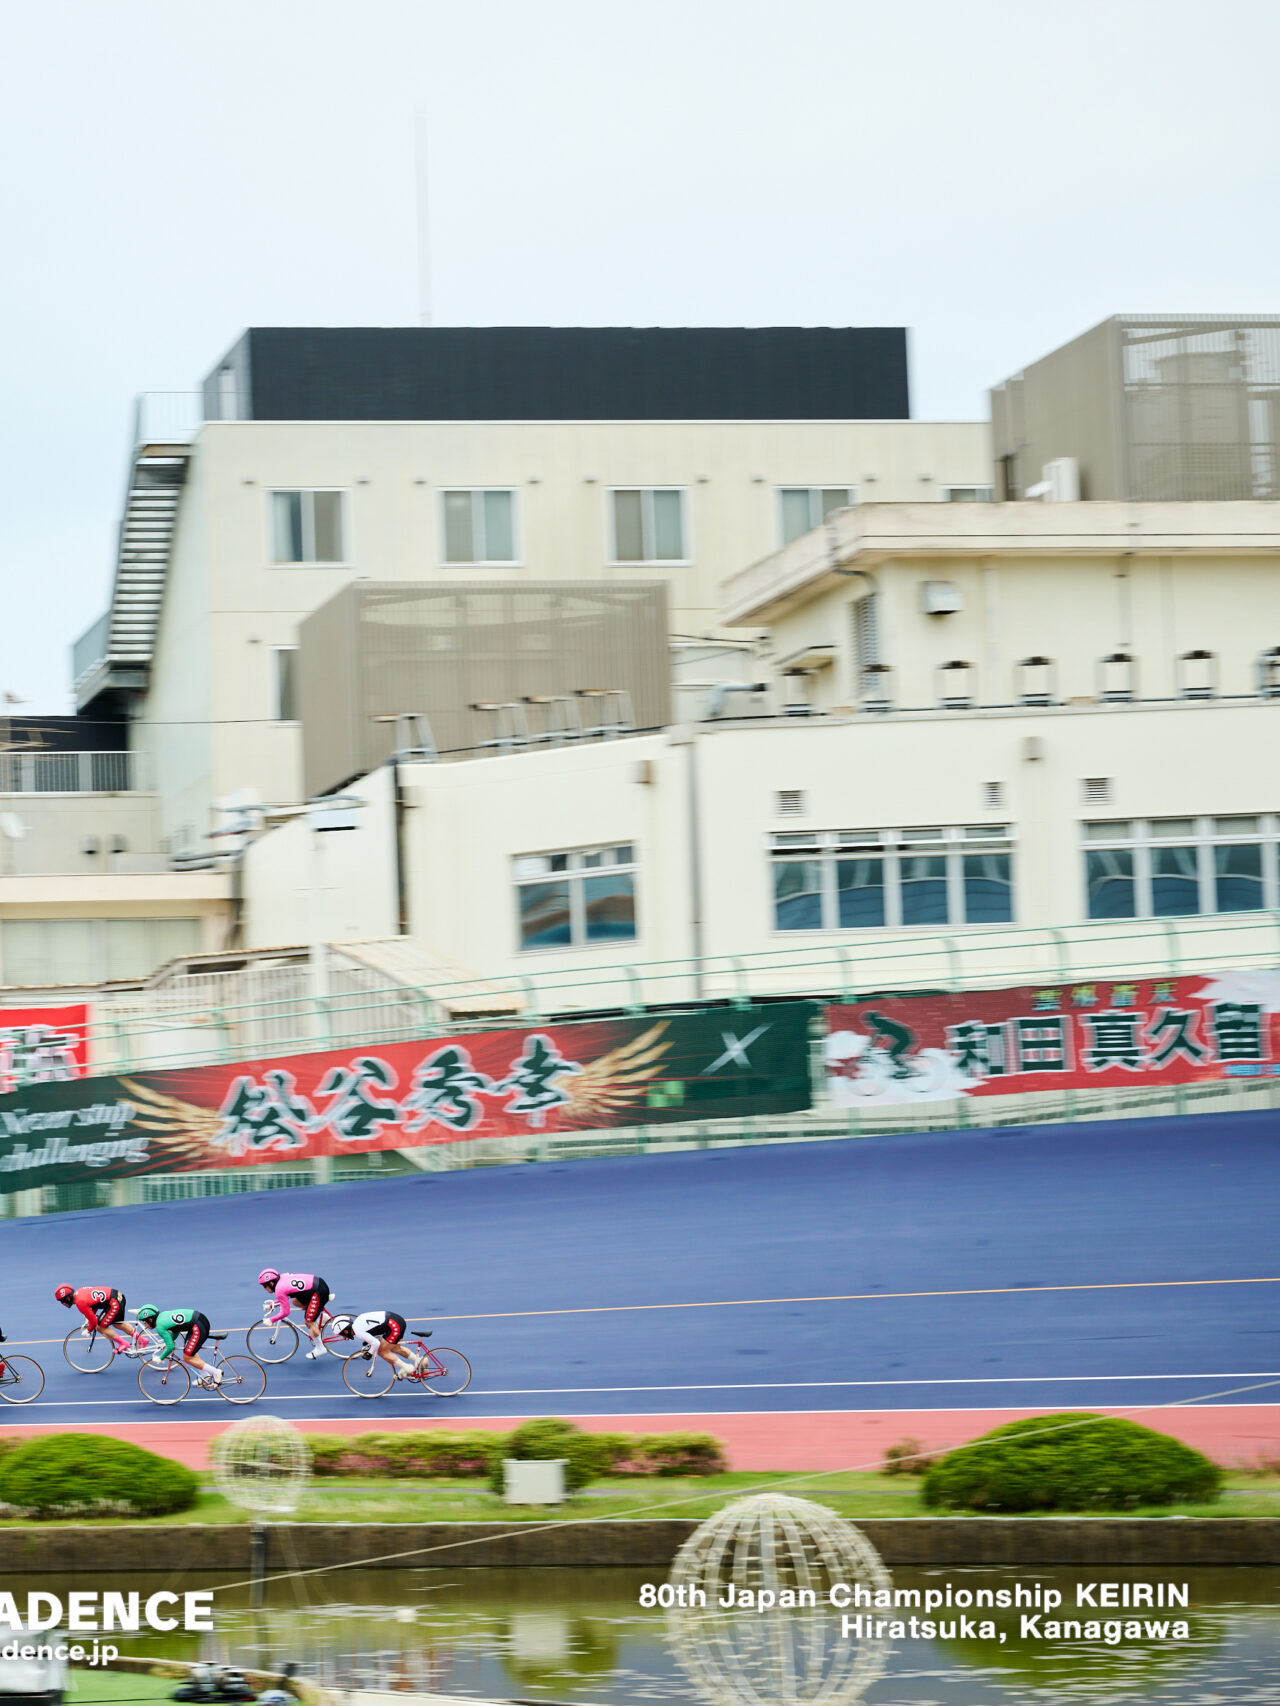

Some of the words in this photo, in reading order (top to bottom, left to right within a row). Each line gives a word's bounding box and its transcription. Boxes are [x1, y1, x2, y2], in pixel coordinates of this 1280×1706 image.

[946, 1000, 1271, 1078] 和田真久留
[291, 1278, 306, 1291] 8
[92, 1290, 107, 1303] 3
[171, 1312, 186, 1325] 6
